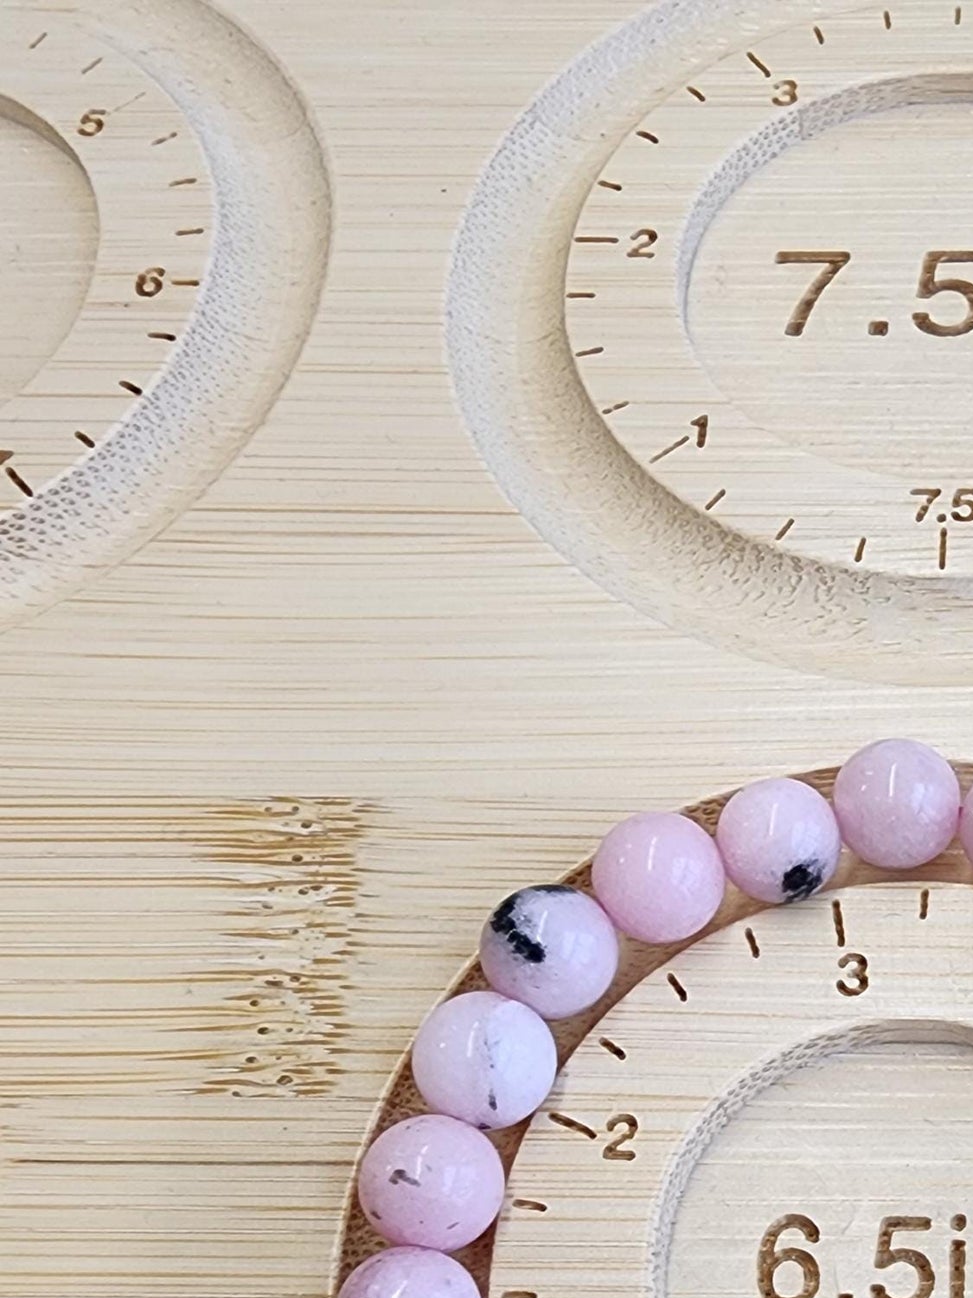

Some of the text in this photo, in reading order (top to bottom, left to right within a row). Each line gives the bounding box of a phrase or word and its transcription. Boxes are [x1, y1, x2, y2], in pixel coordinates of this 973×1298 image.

[772, 80, 798, 106] 3
[77, 110, 105, 136] 5
[626, 229, 658, 258] 2
[134, 267, 164, 296] 6
[689, 414, 709, 447] 1
[836, 954, 868, 996] 3
[602, 1115, 636, 1160] 2
